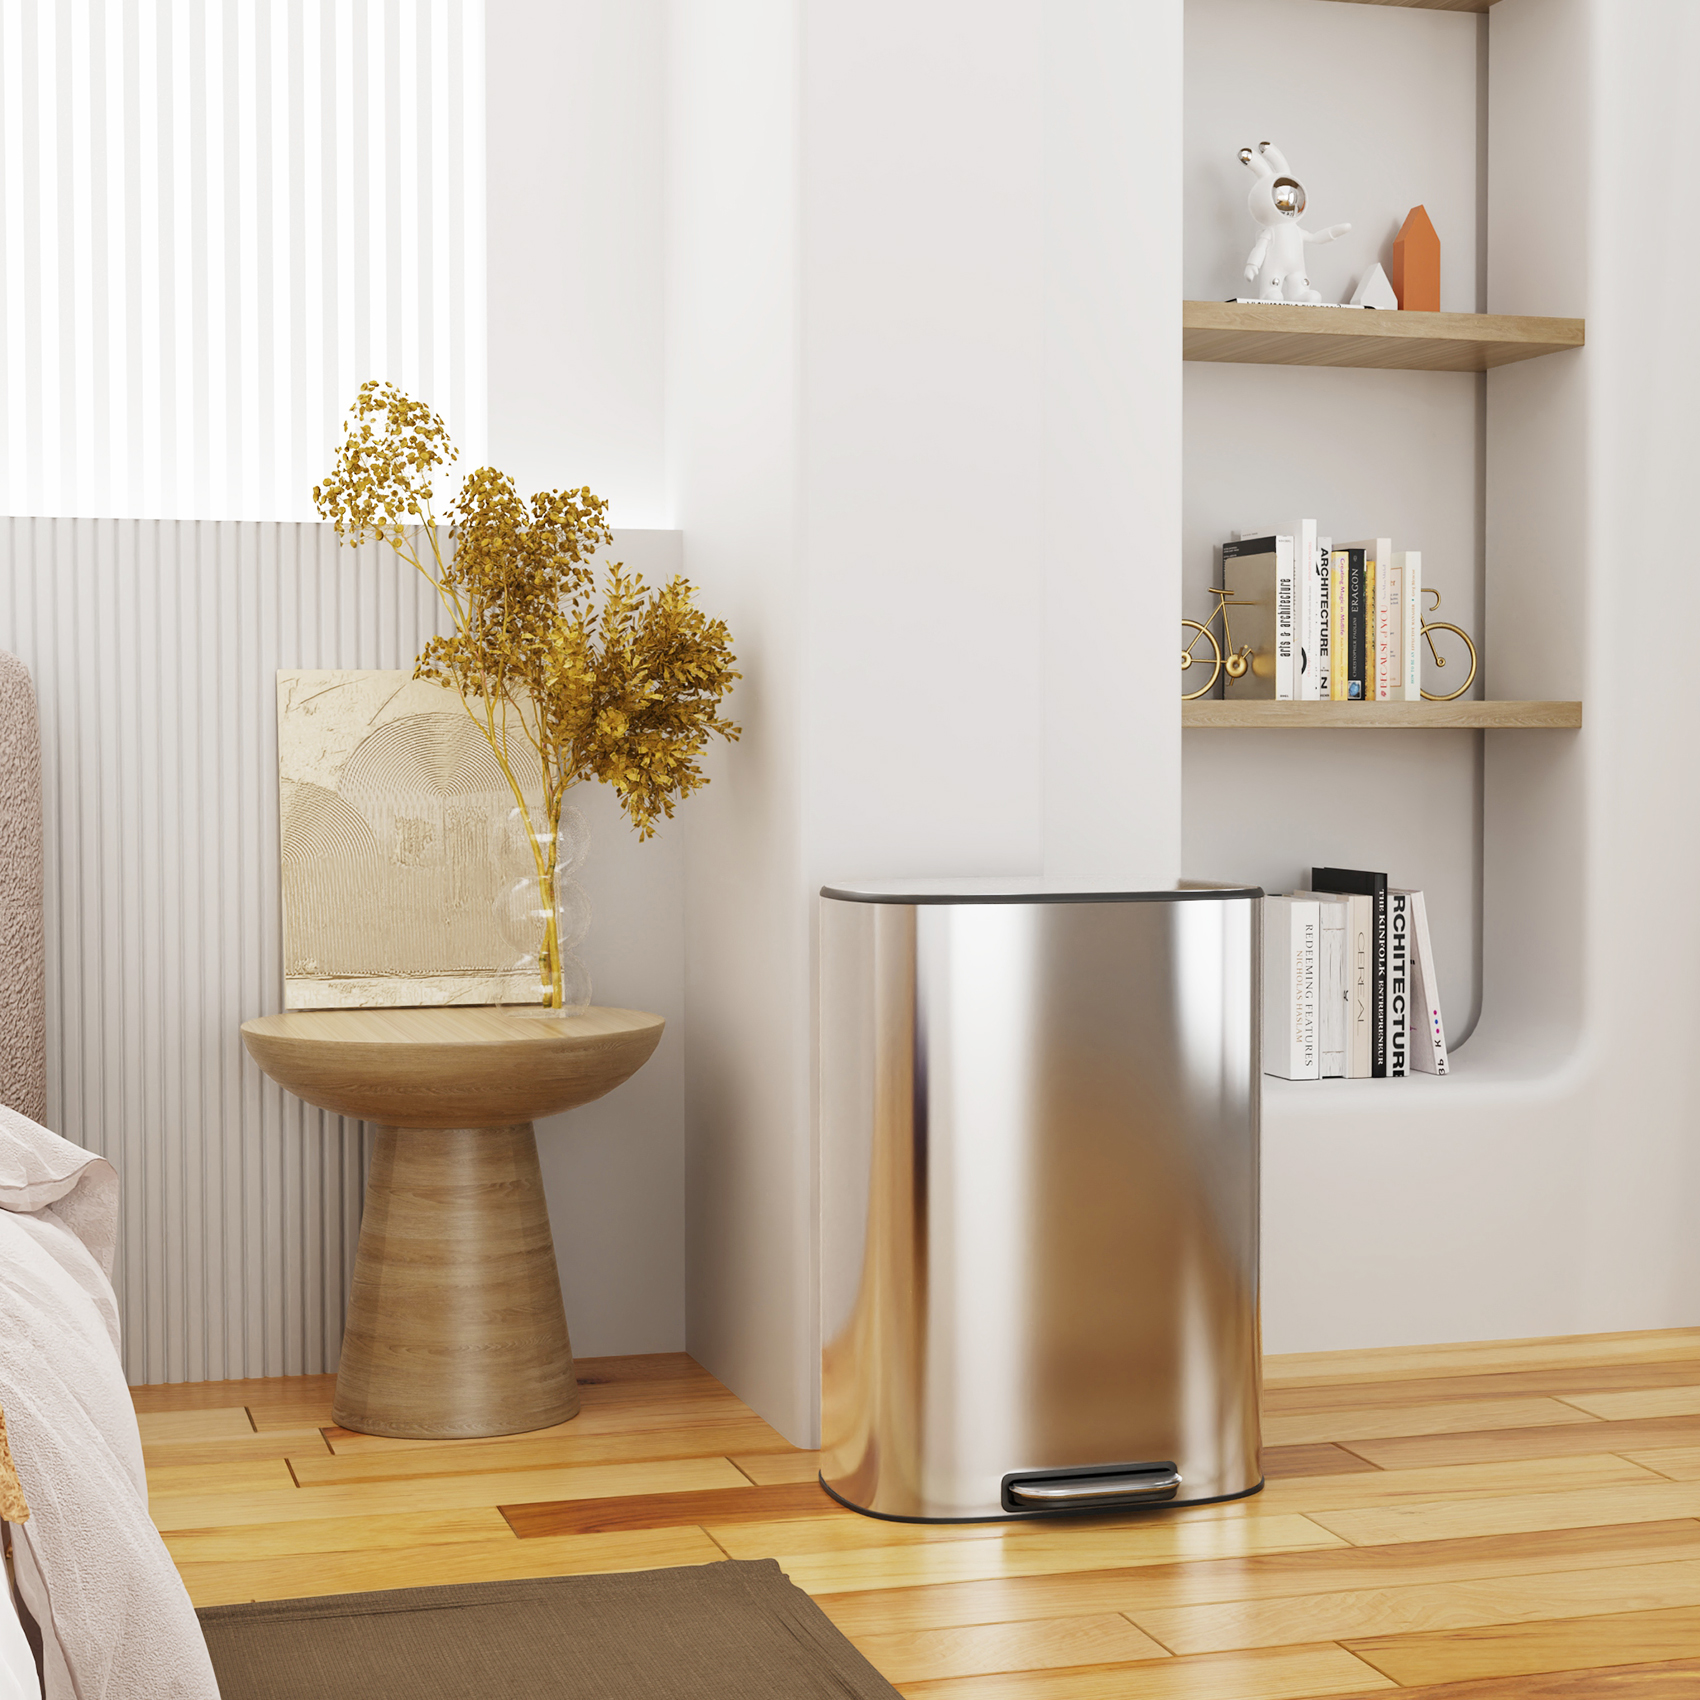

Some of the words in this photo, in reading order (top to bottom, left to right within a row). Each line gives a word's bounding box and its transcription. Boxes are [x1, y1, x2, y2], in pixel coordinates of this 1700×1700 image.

[1277, 579, 1291, 629] architecture
[1320, 548, 1328, 656] ARCHITECTURE
[1351, 568, 1359, 612] ERAGON
[1380, 604, 1388, 629] YOU
[1278, 638, 1291, 657] arts
[1380, 641, 1388, 688] BECAUSE
[1305, 924, 1314, 999] REDEEMING
[1378, 914, 1386, 976] KINFOLK
[1357, 932, 1365, 1036] CEREAL
[1305, 1004, 1314, 1067] FEATURES
[1377, 980, 1385, 1065] ENTREPRENEUR
